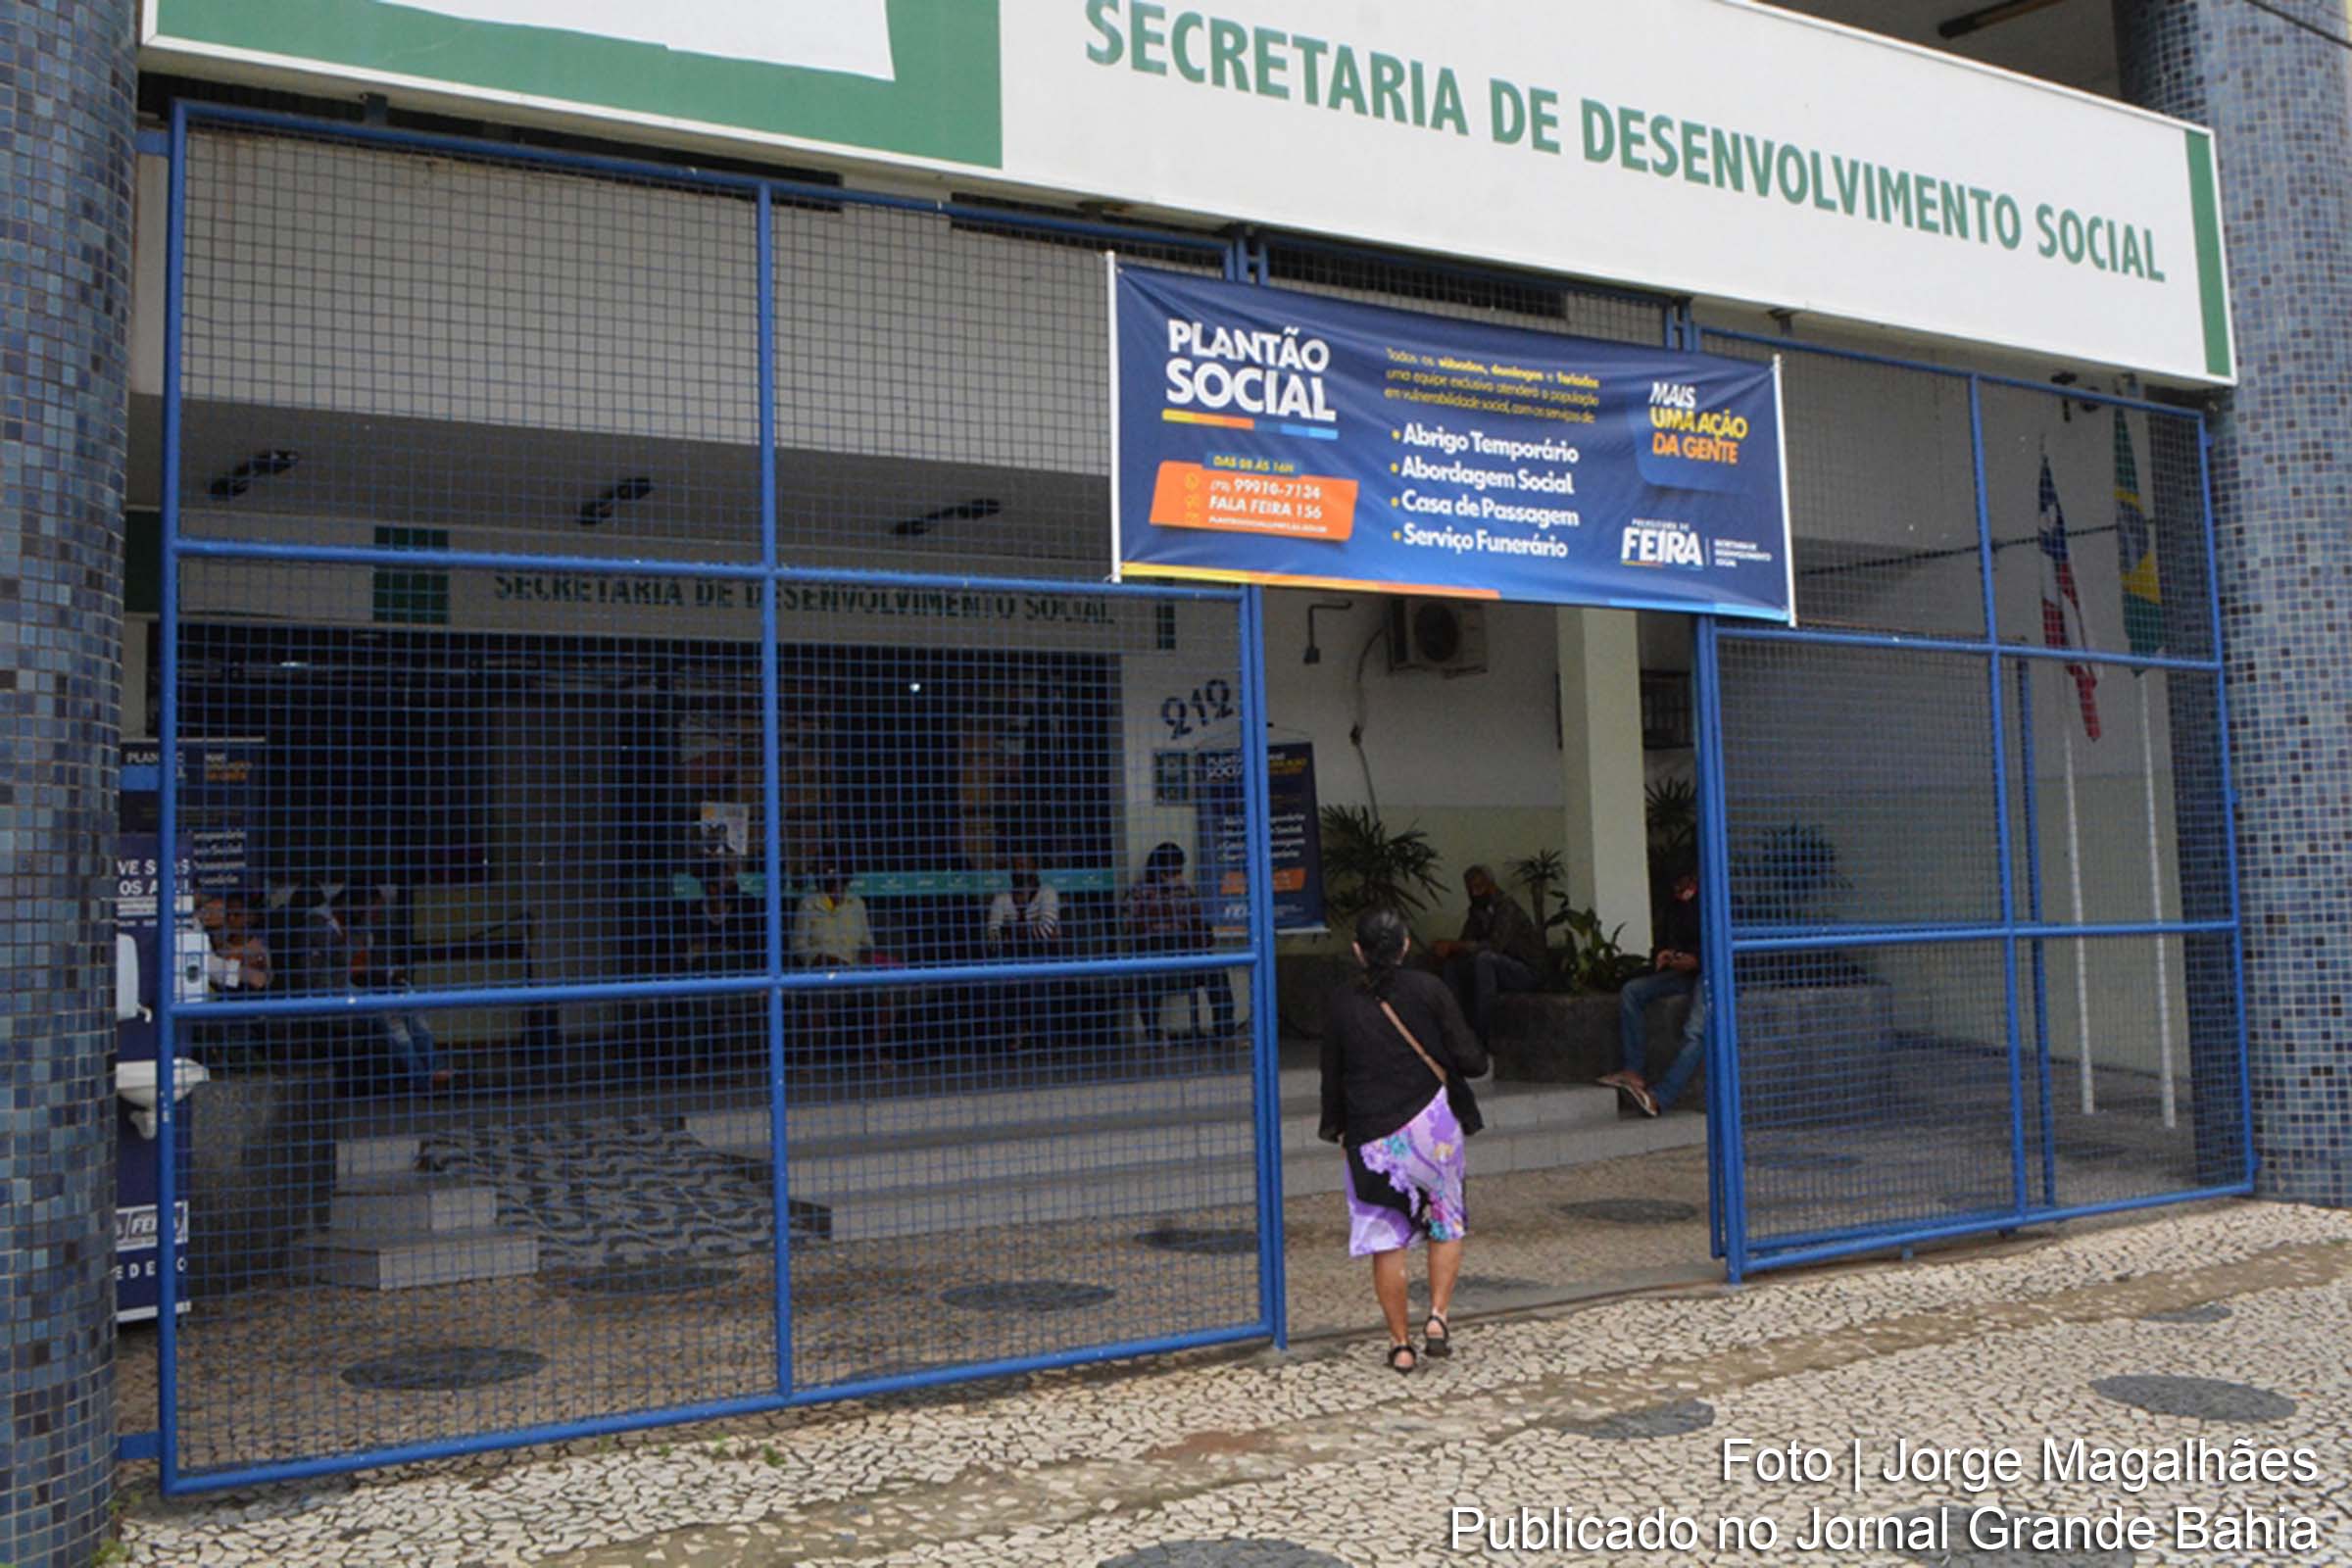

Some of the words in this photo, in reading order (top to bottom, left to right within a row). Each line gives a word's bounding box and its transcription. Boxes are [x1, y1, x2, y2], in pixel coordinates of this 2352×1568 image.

[1086, 0, 1469, 136] SECRETARIA
[1490, 77, 1561, 155] DE
[1581, 98, 2022, 251] DESENVOLVIMENTO
[2036, 203, 2166, 283] SOCIAL
[1167, 318, 1330, 372] PLANTÃO
[1166, 358, 1337, 421] SOCIAL
[1649, 380, 1696, 409] MAIS
[1402, 422, 1469, 455] Abrigo
[1470, 429, 1581, 464] Temporário
[1649, 407, 1695, 432] UMA
[1696, 407, 1748, 440] AÇÃO
[1651, 432, 1681, 459] DA
[1682, 436, 1740, 466] GENTE
[1401, 455, 1516, 490] Abordagem
[1517, 468, 1575, 495] Social
[1208, 494, 1247, 514] FALA
[1250, 498, 1293, 517] FEIRA
[1296, 502, 1323, 520] 156
[1401, 488, 1453, 514] Casa
[1454, 493, 1481, 518] de
[1481, 496, 1581, 529] Passagem
[1403, 521, 1475, 555] Serviço
[1476, 528, 1569, 559] Funerário
[1620, 525, 1704, 567] FEIRA
[494, 573, 684, 608] SECRETARIA
[695, 578, 734, 609] DE
[1024, 594, 1116, 625] SOCIAL
